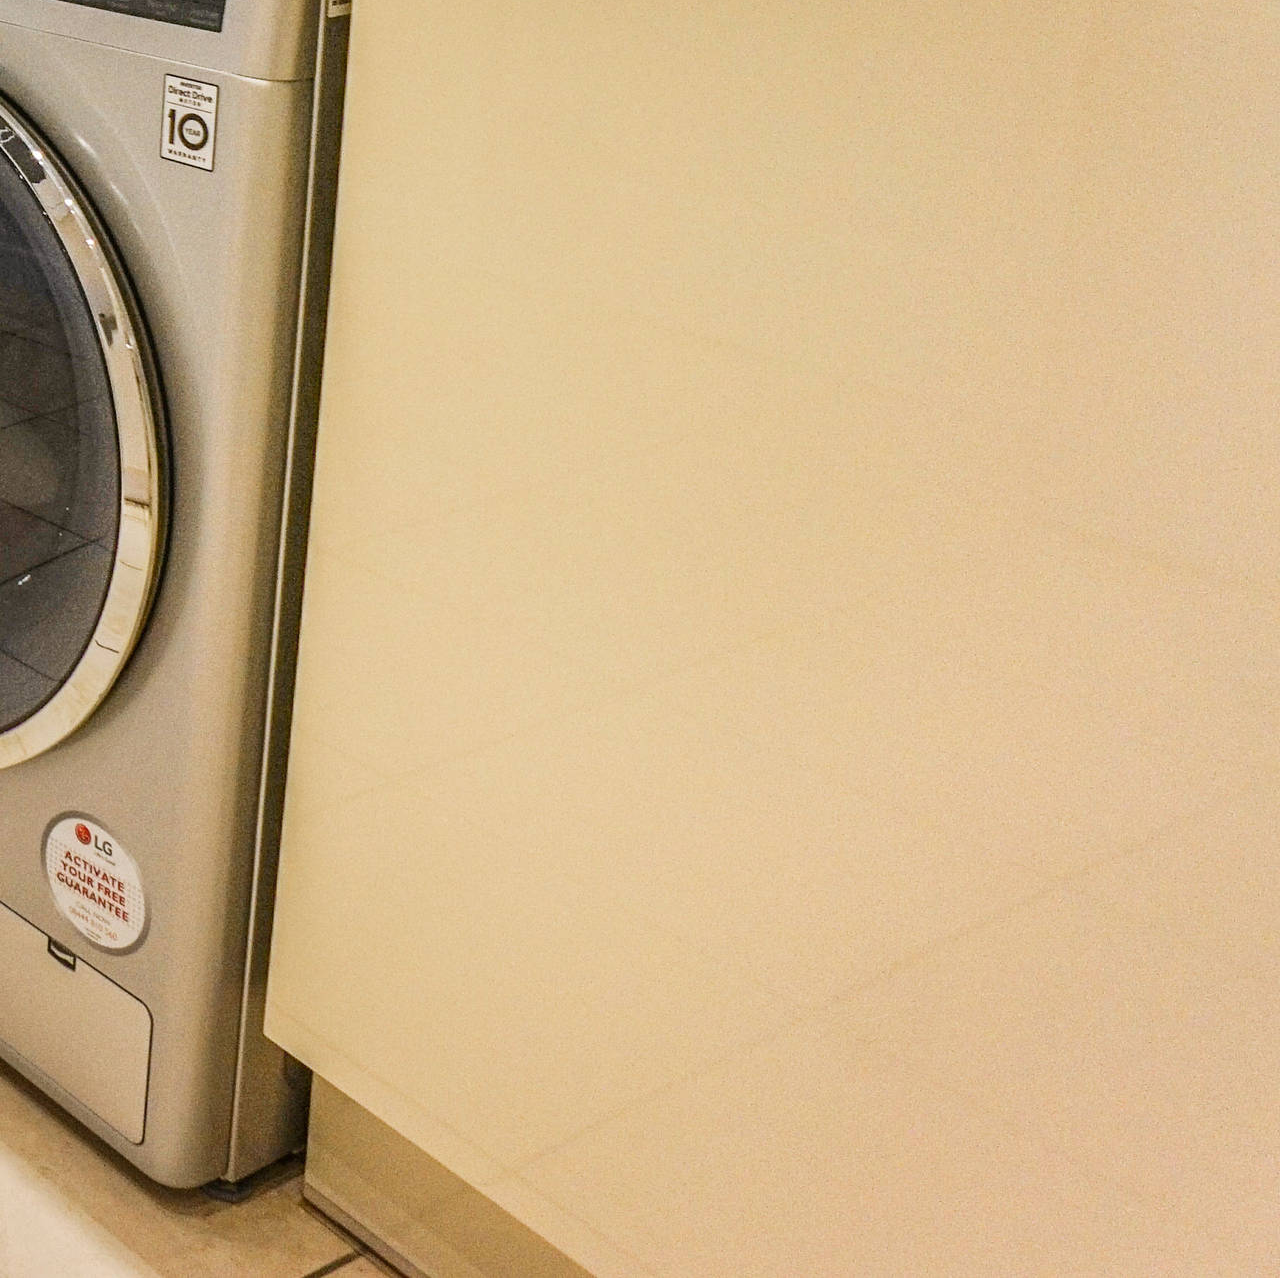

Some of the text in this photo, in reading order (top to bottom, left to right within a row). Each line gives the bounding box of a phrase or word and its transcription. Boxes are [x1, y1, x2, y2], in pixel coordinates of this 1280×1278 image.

[168, 85, 213, 103] Direct Drive
[168, 108, 209, 151] 10
[185, 127, 200, 136] YEAR
[94, 835, 113, 856] LG
[61, 860, 126, 907] YOUR FREE
[65, 850, 125, 892] ACTIVATE
[57, 872, 129, 922] GUARANTEE
